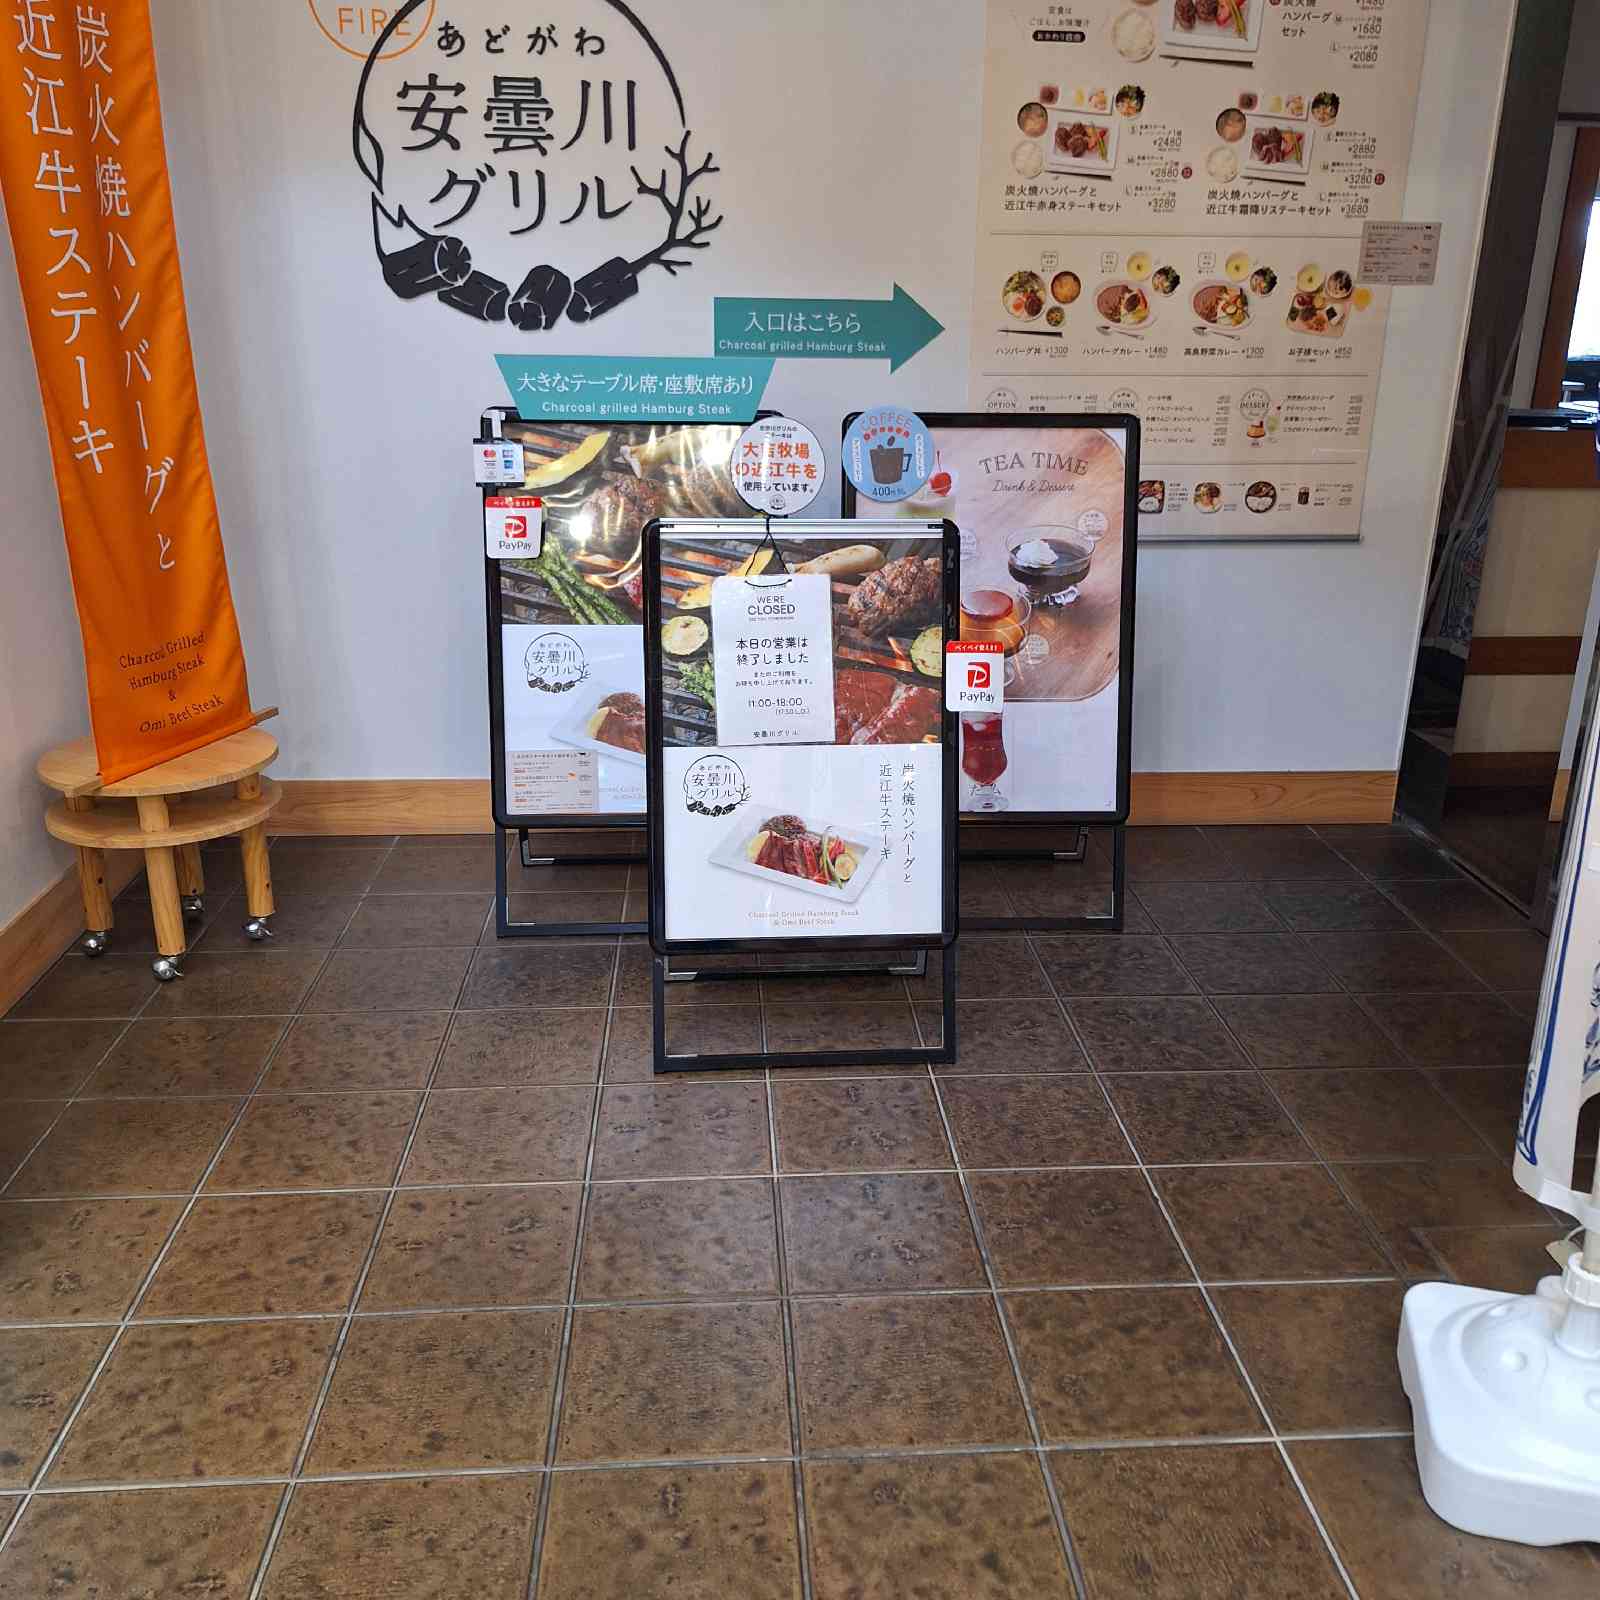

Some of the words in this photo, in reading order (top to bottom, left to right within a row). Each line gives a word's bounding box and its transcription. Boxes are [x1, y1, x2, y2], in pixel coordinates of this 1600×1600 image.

[337, 7, 412, 36] FIRE
[1282, 12, 1333, 24] ハンバーグ
[437, 21, 605, 57] あどがわ
[1282, 26, 1306, 38] セット
[396, 73, 637, 156] 安曇川
[1005, 184, 1097, 197] 炭火焼ハンバーグと
[1207, 189, 1299, 202] 炭火焼ハンバーグと
[428, 163, 633, 235] グリル
[1004, 199, 1122, 213] 近江牛赤身ステーキセット
[16, 0, 115, 474] 近江牛ステーキ
[75, 5, 176, 571] 炭火焼ハンバーグと
[743, 311, 863, 334] 入口はこちら
[719, 339, 767, 351] Charcoal
[769, 340, 803, 353] grilled
[806, 341, 853, 353] Hamburg
[855, 342, 887, 352] Steak
[516, 372, 753, 395] 大きなテーブル席・座敷席あり
[542, 401, 596, 413] Charcoal
[600, 401, 638, 416] grilled
[641, 402, 694, 416] Hamburg
[698, 402, 731, 414] Steak
[978, 451, 1025, 474] TEA
[1031, 451, 1089, 476] TIME
[991, 479, 1026, 492] Drink
[1037, 479, 1075, 493] Dessert
[498, 540, 532, 551] PayPay
[747, 603, 796, 616] CLOSED
[165, 630, 206, 656] Grilled
[736, 637, 809, 650] 本日の営業は
[175, 652, 206, 674] Steak
[532, 650, 577, 664] 安曇川
[736, 652, 809, 666] 終了しました
[537, 664, 575, 677] グリル
[191, 694, 225, 715] Steak
[959, 691, 995, 704] PayPay
[691, 772, 737, 787] 安曇川
[696, 787, 734, 800] グリル
[879, 763, 893, 861] 近江牛ステーキ
